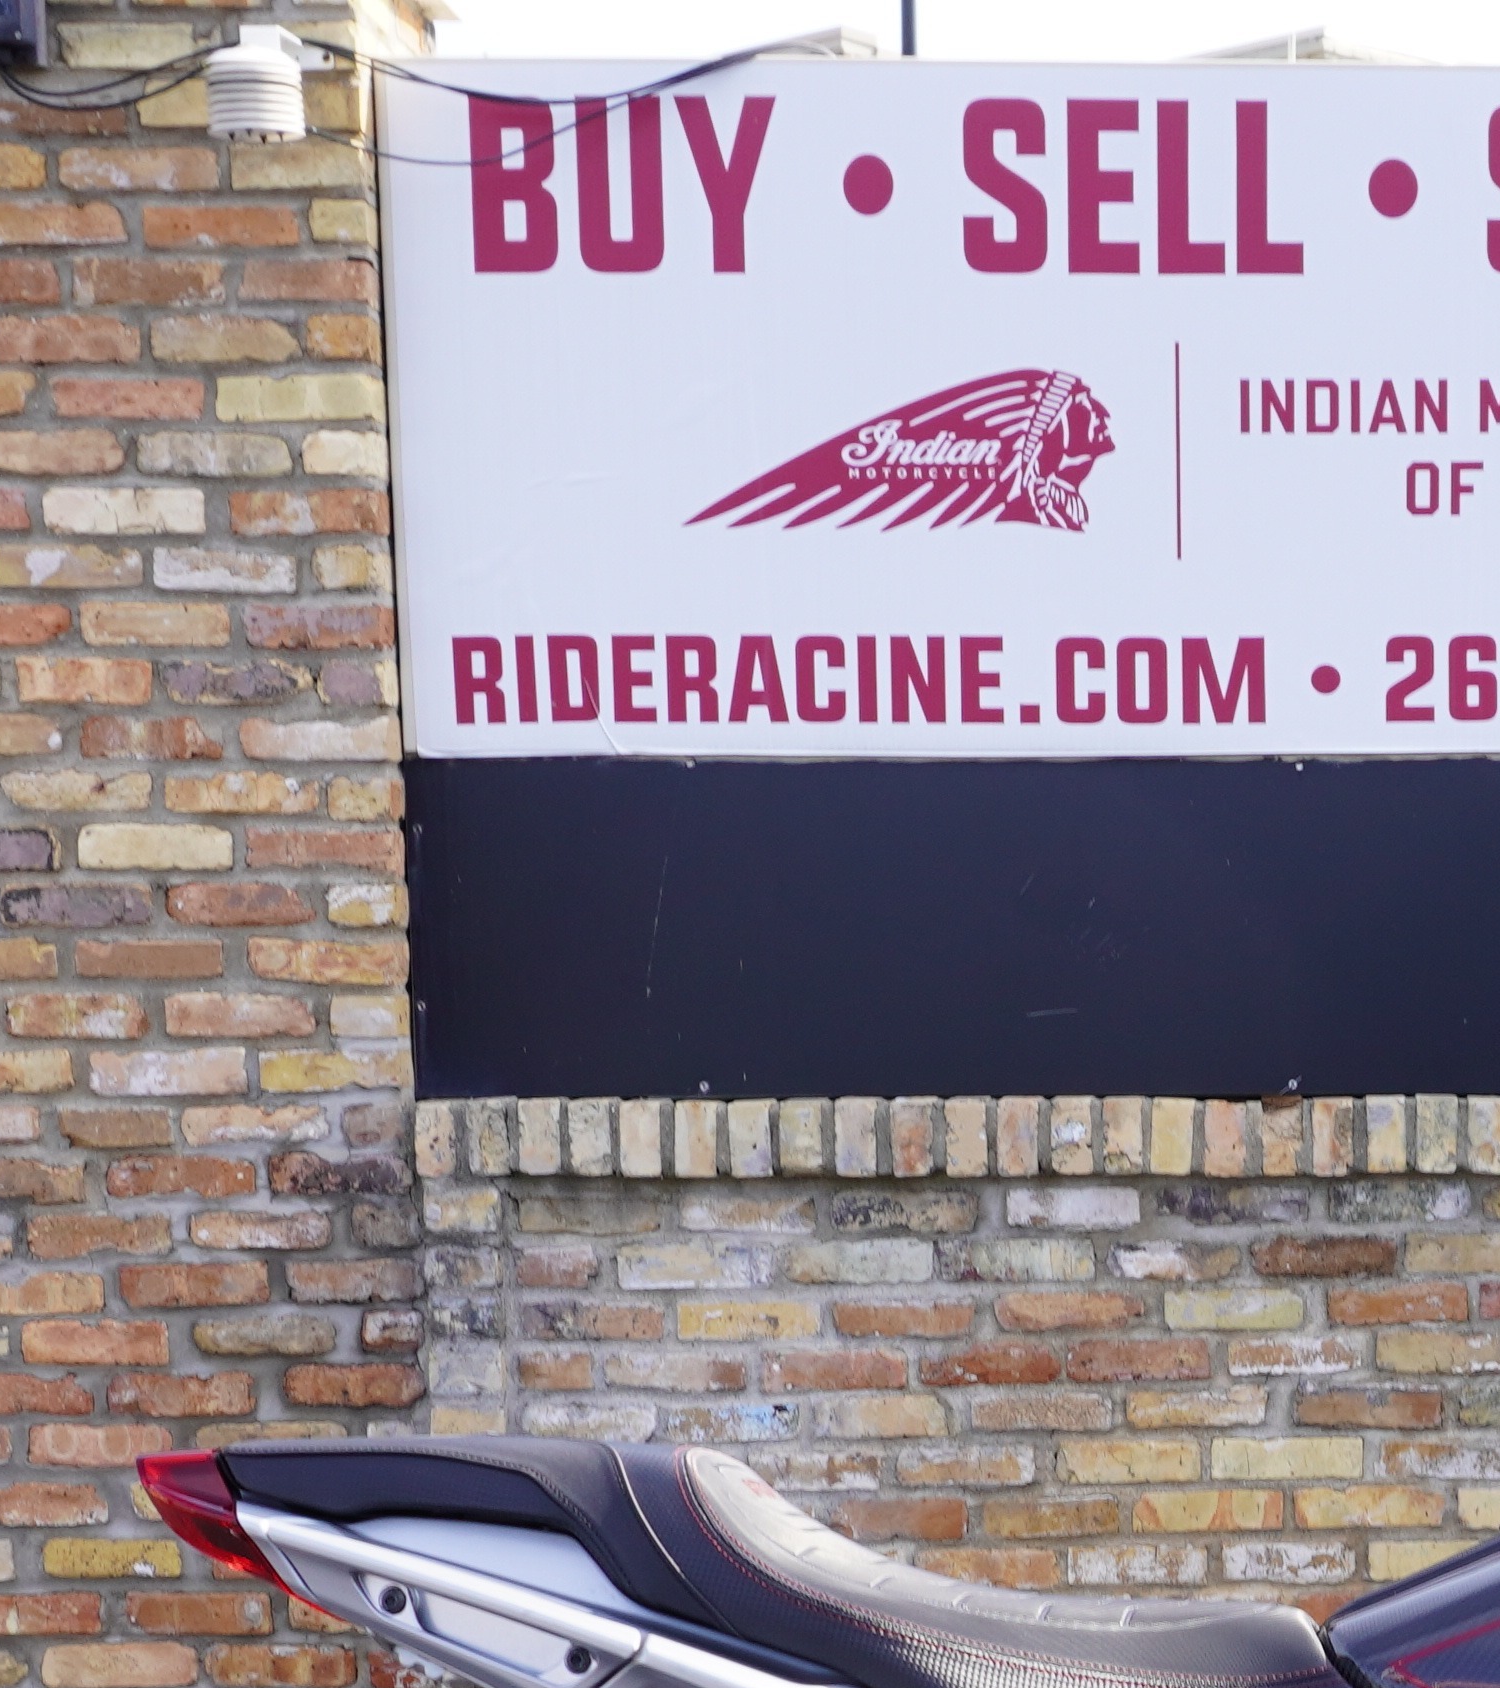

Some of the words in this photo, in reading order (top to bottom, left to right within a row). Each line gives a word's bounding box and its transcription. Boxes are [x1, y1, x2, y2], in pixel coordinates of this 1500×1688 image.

[468, 95, 776, 275] BUY
[962, 98, 1304, 276] SELL
[1238, 378, 1449, 434] INDIAN
[840, 418, 1001, 468] Indian
[847, 466, 997, 481] MOTORCYCLE
[1405, 460, 1484, 517] OF
[450, 634, 1267, 726] RIDERACINE.COM
